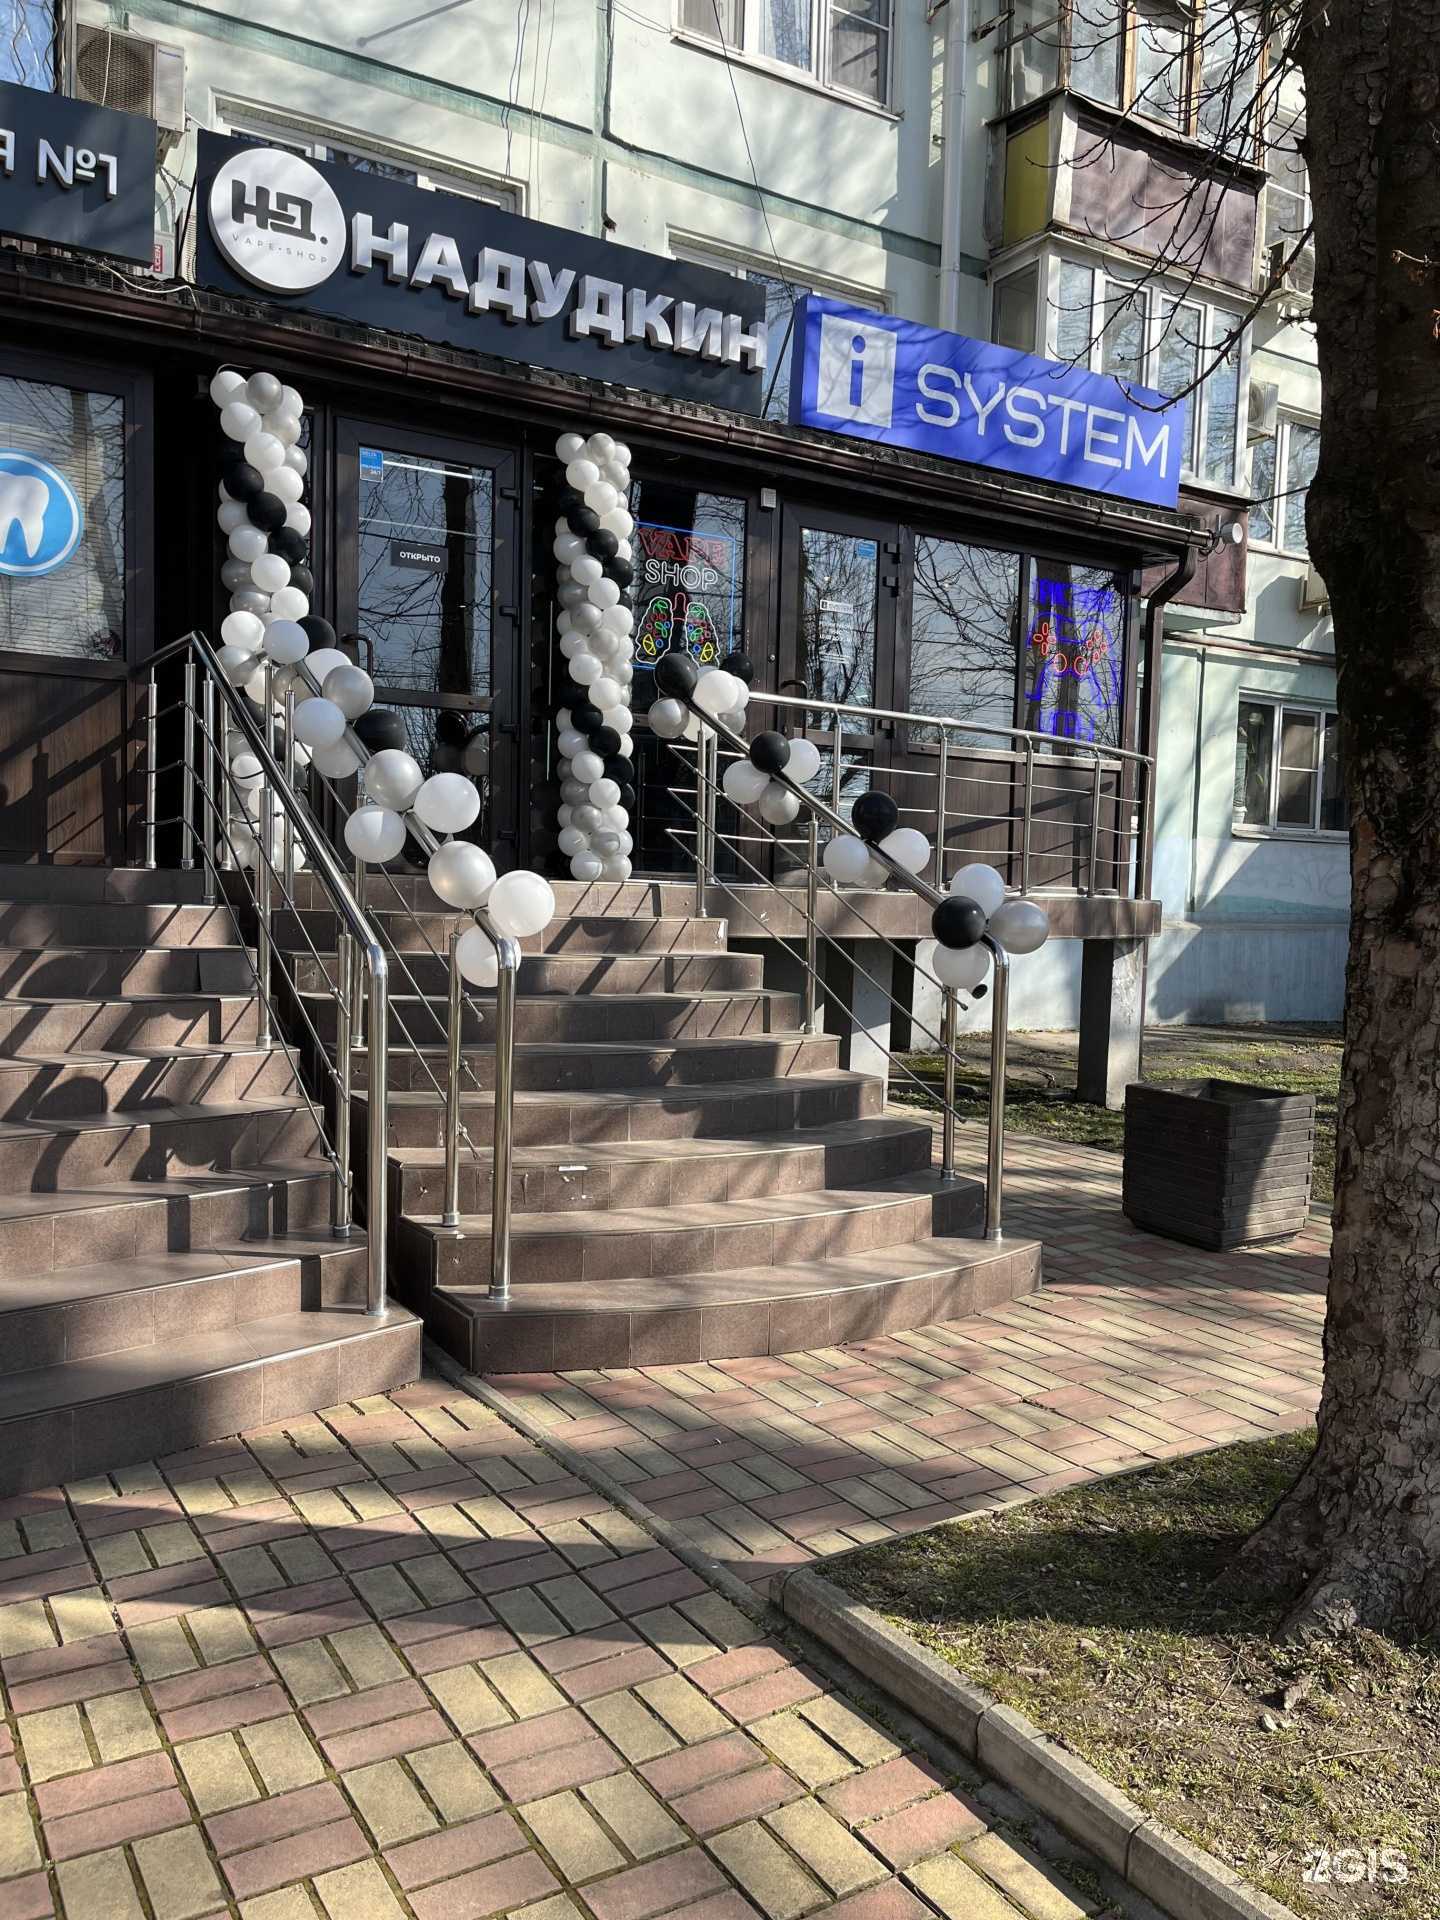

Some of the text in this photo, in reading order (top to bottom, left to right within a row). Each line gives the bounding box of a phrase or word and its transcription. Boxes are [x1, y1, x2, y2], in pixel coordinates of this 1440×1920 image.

[351, 211, 768, 371] НАДУДКИН
[915, 363, 1171, 479] SYSTEM
[399, 551, 441, 564] ОТКРЫТО
[639, 528, 726, 571] VAPE
[645, 558, 719, 592] SHOP
